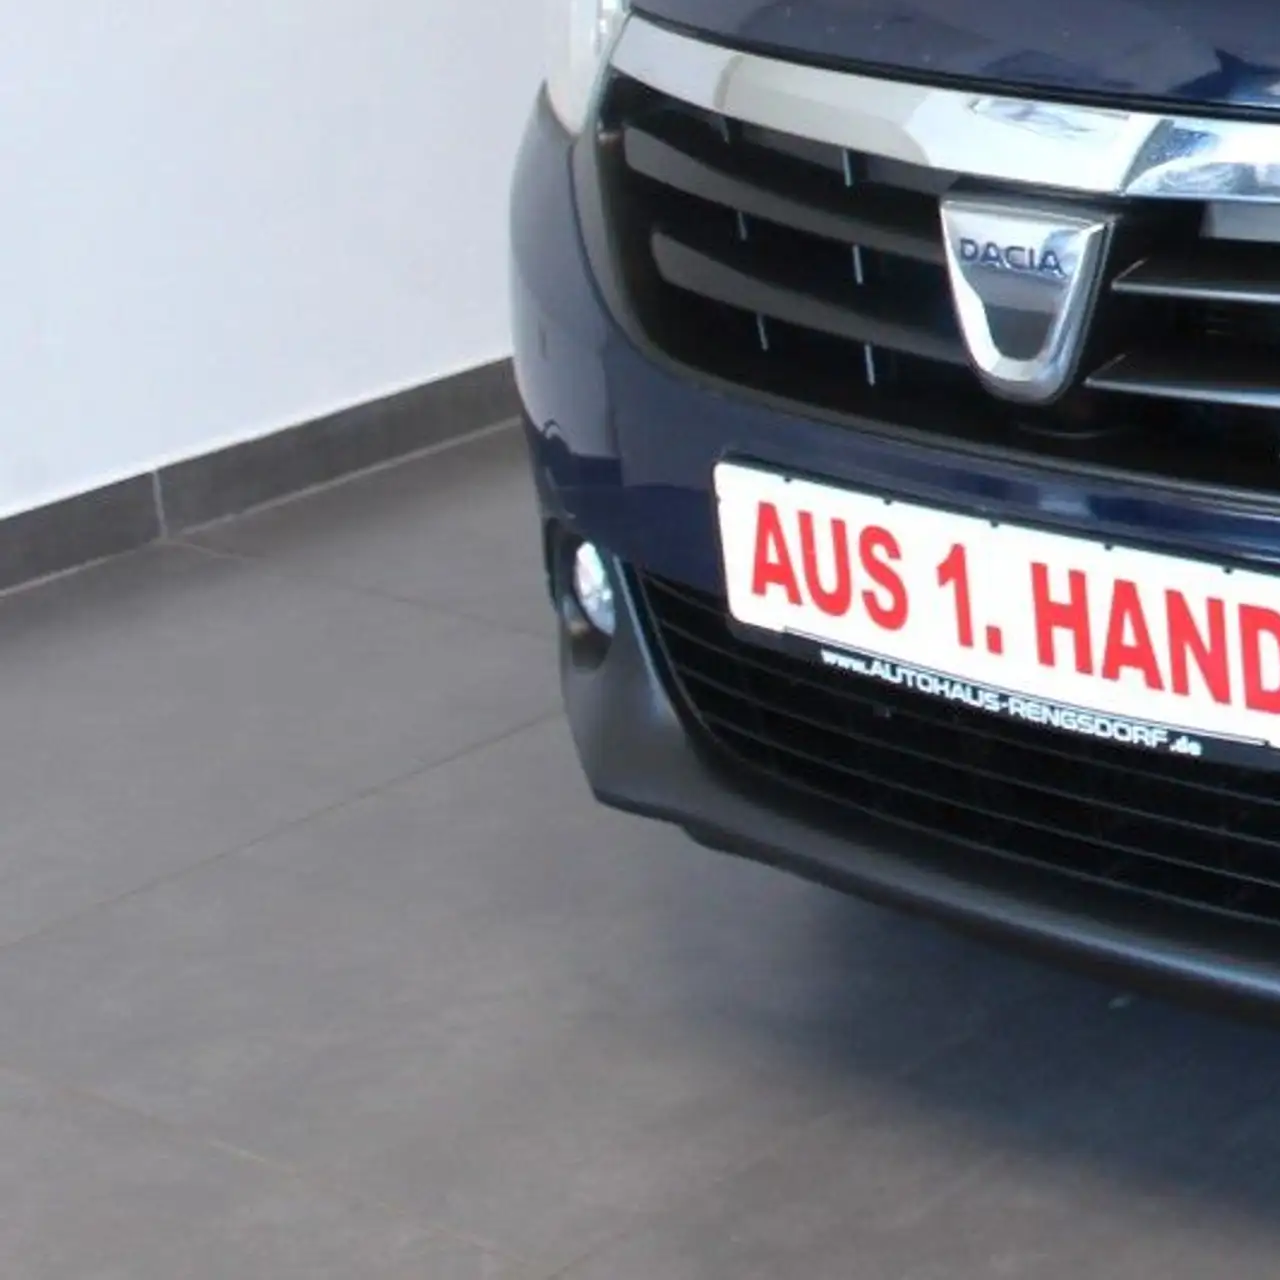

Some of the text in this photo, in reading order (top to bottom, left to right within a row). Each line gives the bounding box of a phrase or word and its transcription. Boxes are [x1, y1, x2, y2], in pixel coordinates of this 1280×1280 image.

[959, 237, 1067, 277] DACIA
[752, 502, 908, 630] AUS
[936, 544, 1005, 654] 1.
